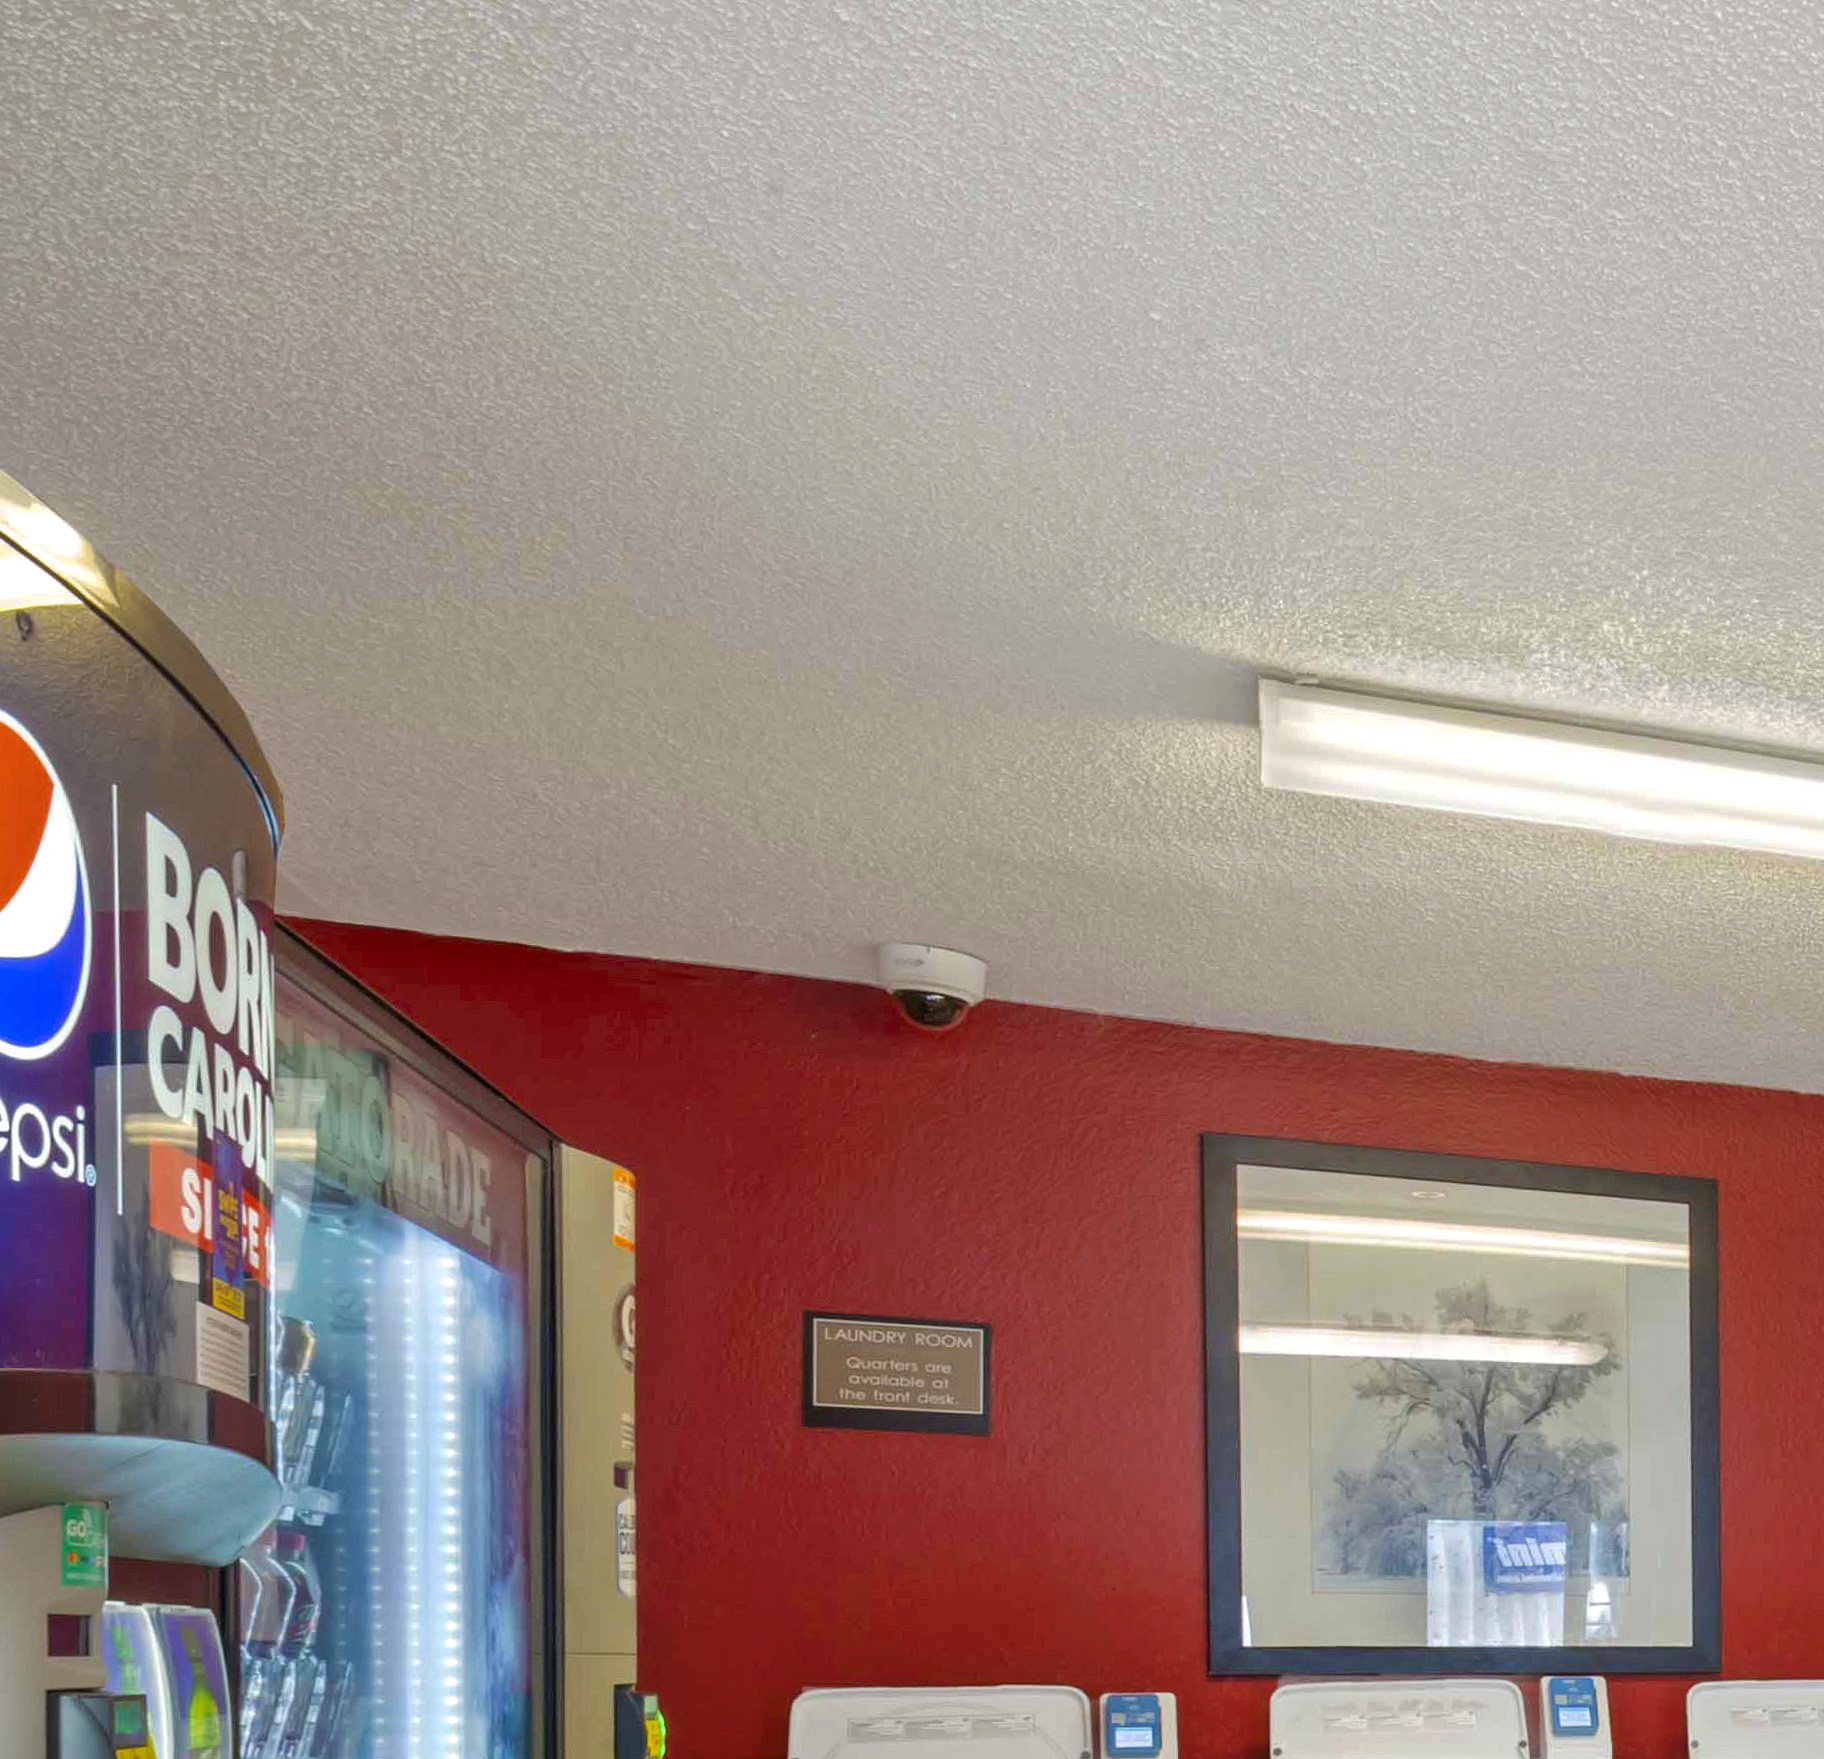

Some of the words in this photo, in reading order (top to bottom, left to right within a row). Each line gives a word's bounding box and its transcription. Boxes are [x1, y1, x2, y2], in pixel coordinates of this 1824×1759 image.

[824, 1327, 906, 1345] LAUNDRY
[915, 1332, 973, 1348] ROOM
[846, 1356, 918, 1372] Quarters
[924, 1363, 952, 1374] are
[849, 1372, 925, 1388] available
[932, 1378, 949, 1389] at
[839, 1388, 866, 1401] the
[873, 1389, 910, 1404] front
[917, 1392, 960, 1405] desk.
